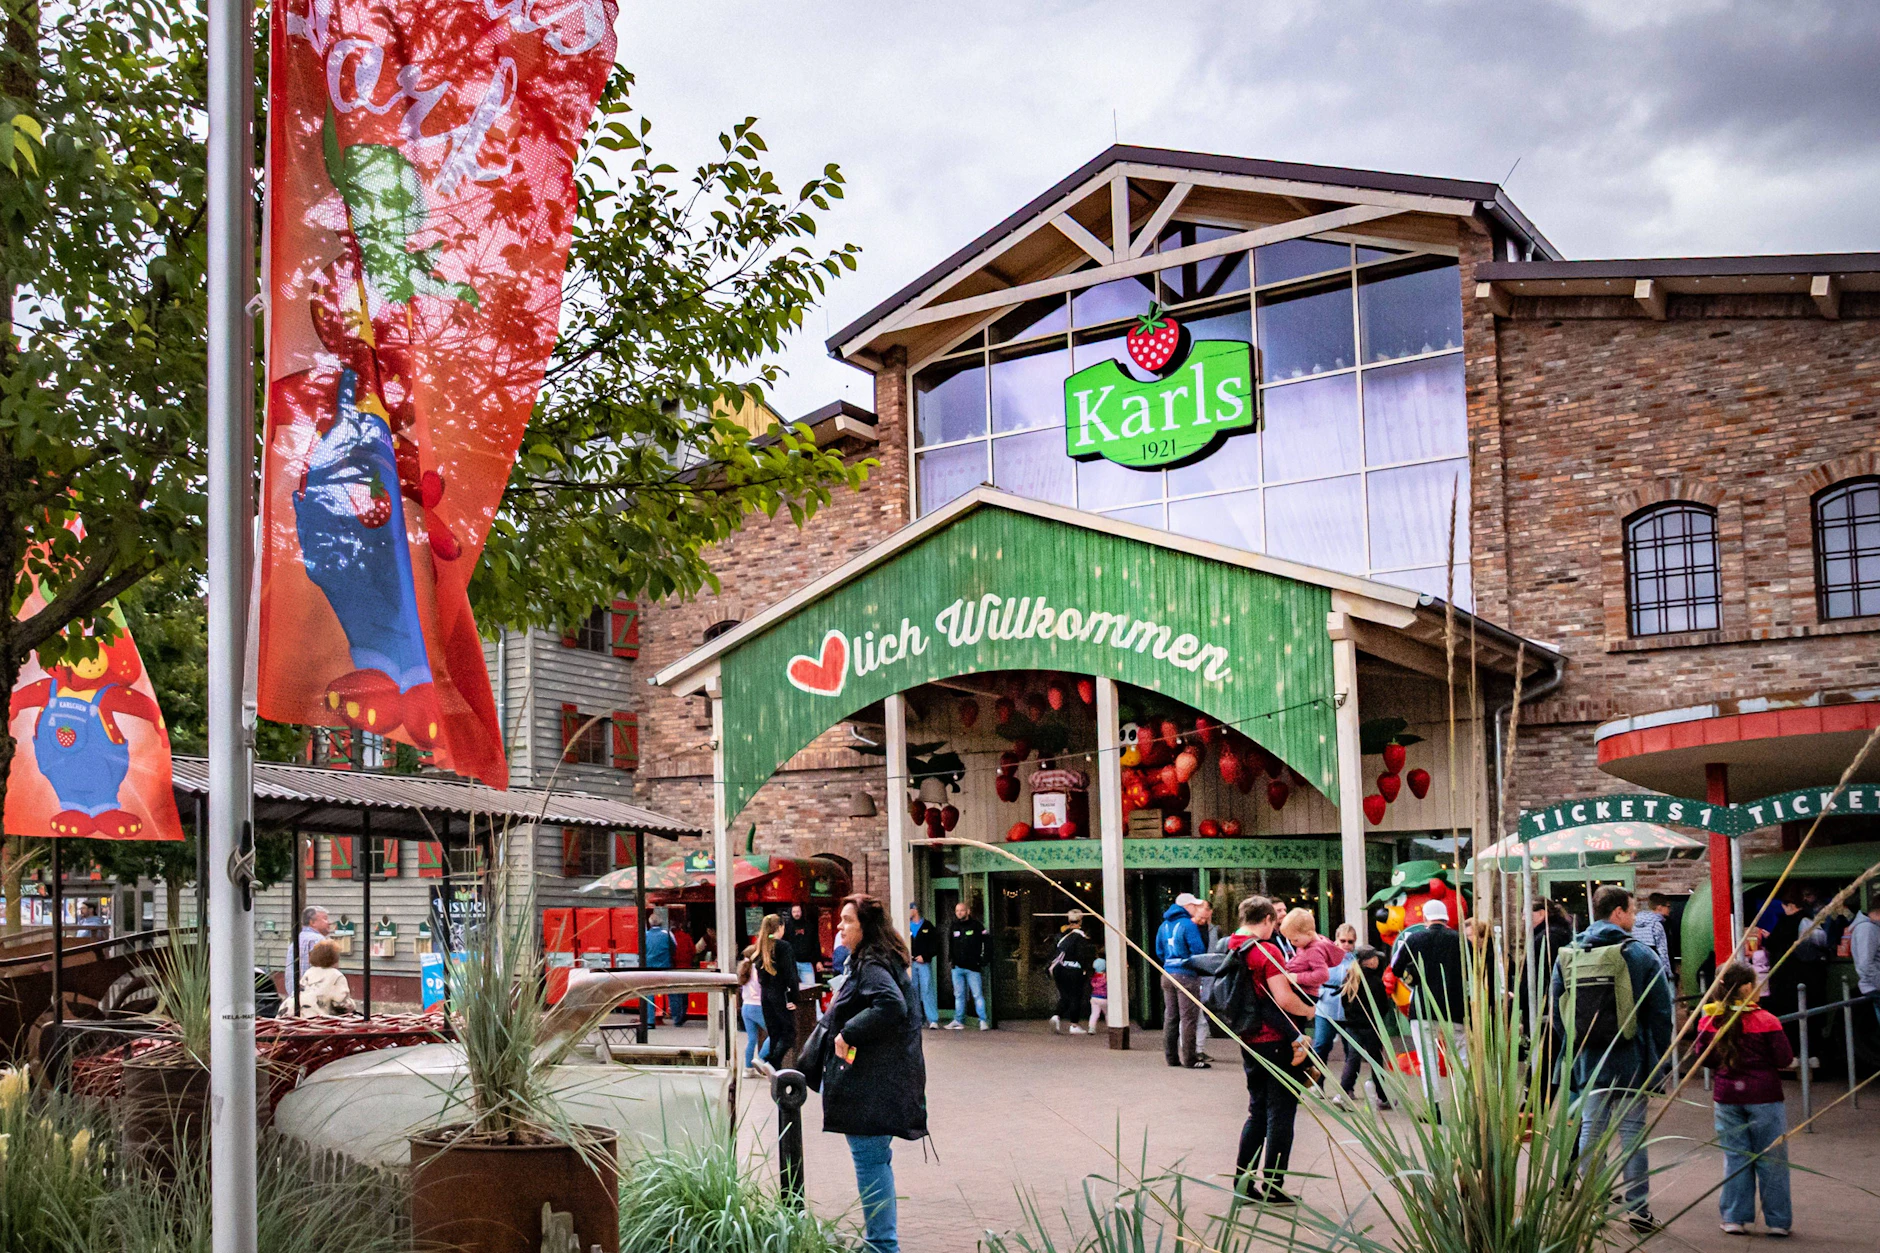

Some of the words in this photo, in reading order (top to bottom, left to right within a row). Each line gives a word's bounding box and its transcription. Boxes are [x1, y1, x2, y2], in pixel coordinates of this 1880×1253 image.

[1073, 361, 1244, 447] Karls
[1142, 438, 1176, 460] 1921
[853, 617, 930, 677] lich
[935, 593, 1231, 682] Willkommen
[1532, 800, 1684, 831] TICKETS
[1700, 808, 1713, 826] 1
